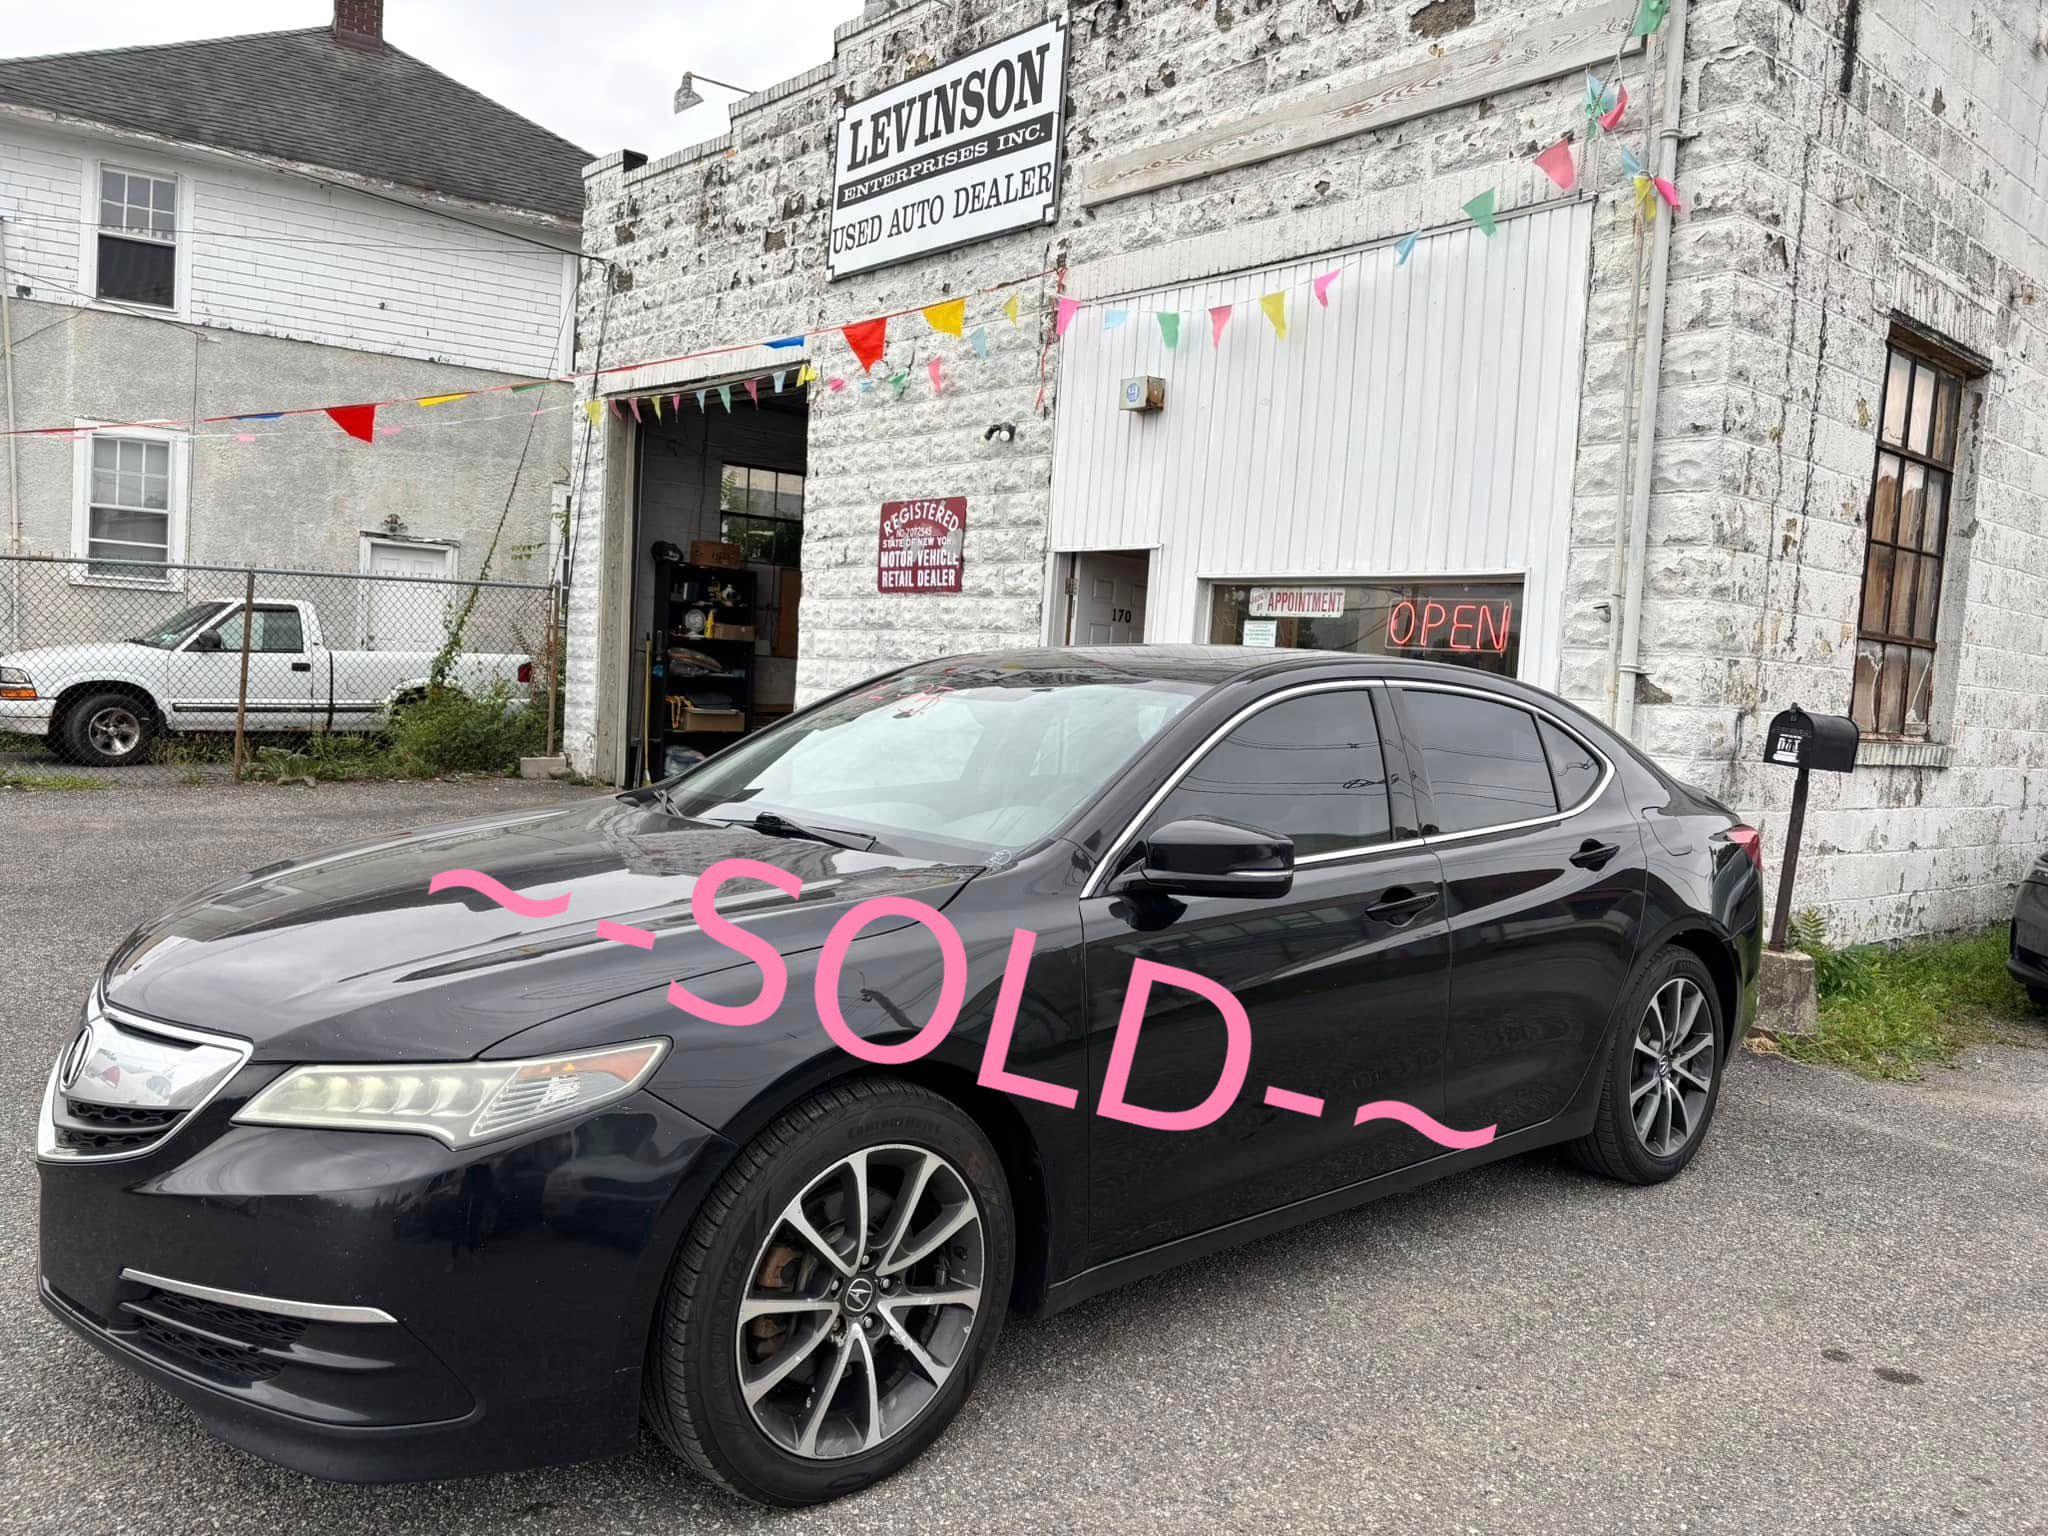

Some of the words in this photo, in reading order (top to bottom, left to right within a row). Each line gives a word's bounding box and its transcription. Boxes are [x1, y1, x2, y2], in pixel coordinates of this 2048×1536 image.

[847, 43, 1050, 172] LEVINSON
[843, 141, 988, 202] ENTERPRISES
[996, 124, 1045, 151] INC.
[832, 215, 882, 254] USED
[888, 195, 944, 237] AUTO
[953, 162, 1052, 218] DEALER
[883, 502, 959, 536] REGISTERED
[882, 537, 904, 549] STATE
[919, 536, 935, 546] NEW
[880, 550, 913, 568] MOTOR
[917, 549, 959, 567] VEHICLE
[882, 569, 914, 588] RETAIL
[917, 569, 956, 587] DEALER
[1112, 608, 1132, 623] 170
[1267, 592, 1344, 613] APPOINTMENT
[1389, 600, 1510, 650] OPEN
